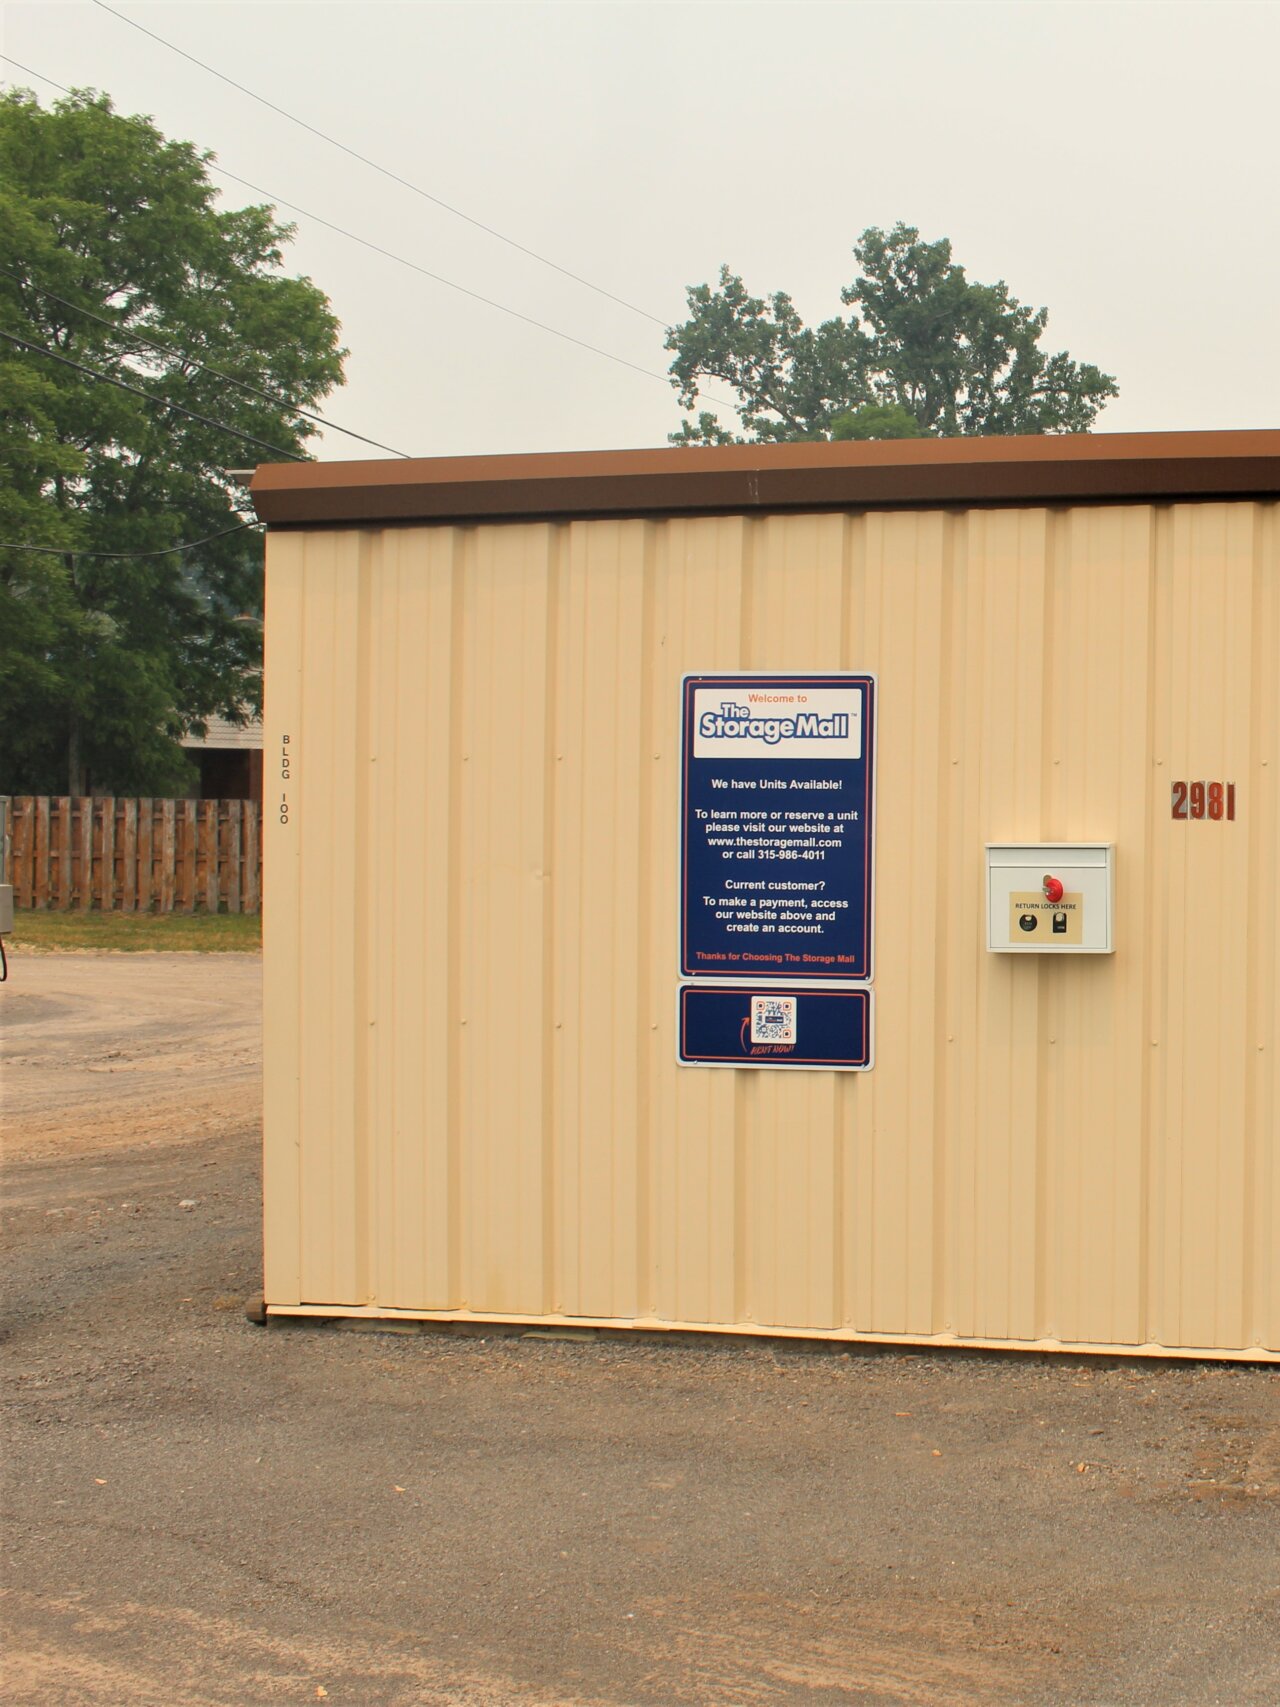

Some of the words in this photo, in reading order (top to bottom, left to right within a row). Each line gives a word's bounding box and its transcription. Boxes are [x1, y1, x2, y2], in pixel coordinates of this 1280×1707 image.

[748, 694, 794, 703] Welcome
[797, 695, 807, 703] to
[721, 702, 750, 718] The
[282, 735, 290, 779] BLDG
[711, 779, 728, 789] We
[731, 779, 756, 789] have
[759, 780, 787, 789] Units
[790, 780, 842, 790] Available!
[1171, 781, 1236, 821] 2981
[695, 809, 708, 819] To
[711, 809, 737, 819] learn
[740, 811, 767, 819] more
[771, 811, 782, 819] or
[785, 811, 824, 820] reserve
[828, 812, 834, 820] a
[837, 811, 858, 820] unit
[705, 823, 740, 833] please
[743, 823, 765, 832] visit
[768, 824, 786, 832] our
[789, 823, 830, 832] website
[833, 824, 844, 833] at
[708, 837, 842, 848] www.thestoragemall.com
[722, 850, 732, 859] or
[736, 850, 755, 859] call
[758, 850, 825, 860] 315-986-4011
[725, 880, 765, 889] Current
[768, 881, 826, 890] customer?
[703, 896, 716, 906] To
[719, 897, 747, 906] make
[750, 898, 756, 906] a
[759, 898, 808, 909] payment,
[811, 900, 848, 908] access
[716, 911, 733, 919] our
[736, 910, 777, 920] website
[780, 911, 812, 920] above
[815, 911, 835, 920] and
[726, 923, 759, 932] create
[762, 924, 775, 932] an
[778, 924, 824, 933] account.
[696, 952, 726, 960] Thanks
[729, 952, 740, 960] for
[742, 952, 783, 963] Choosing
[803, 954, 835, 964] Storage
[750, 1046, 772, 1055] RENT
